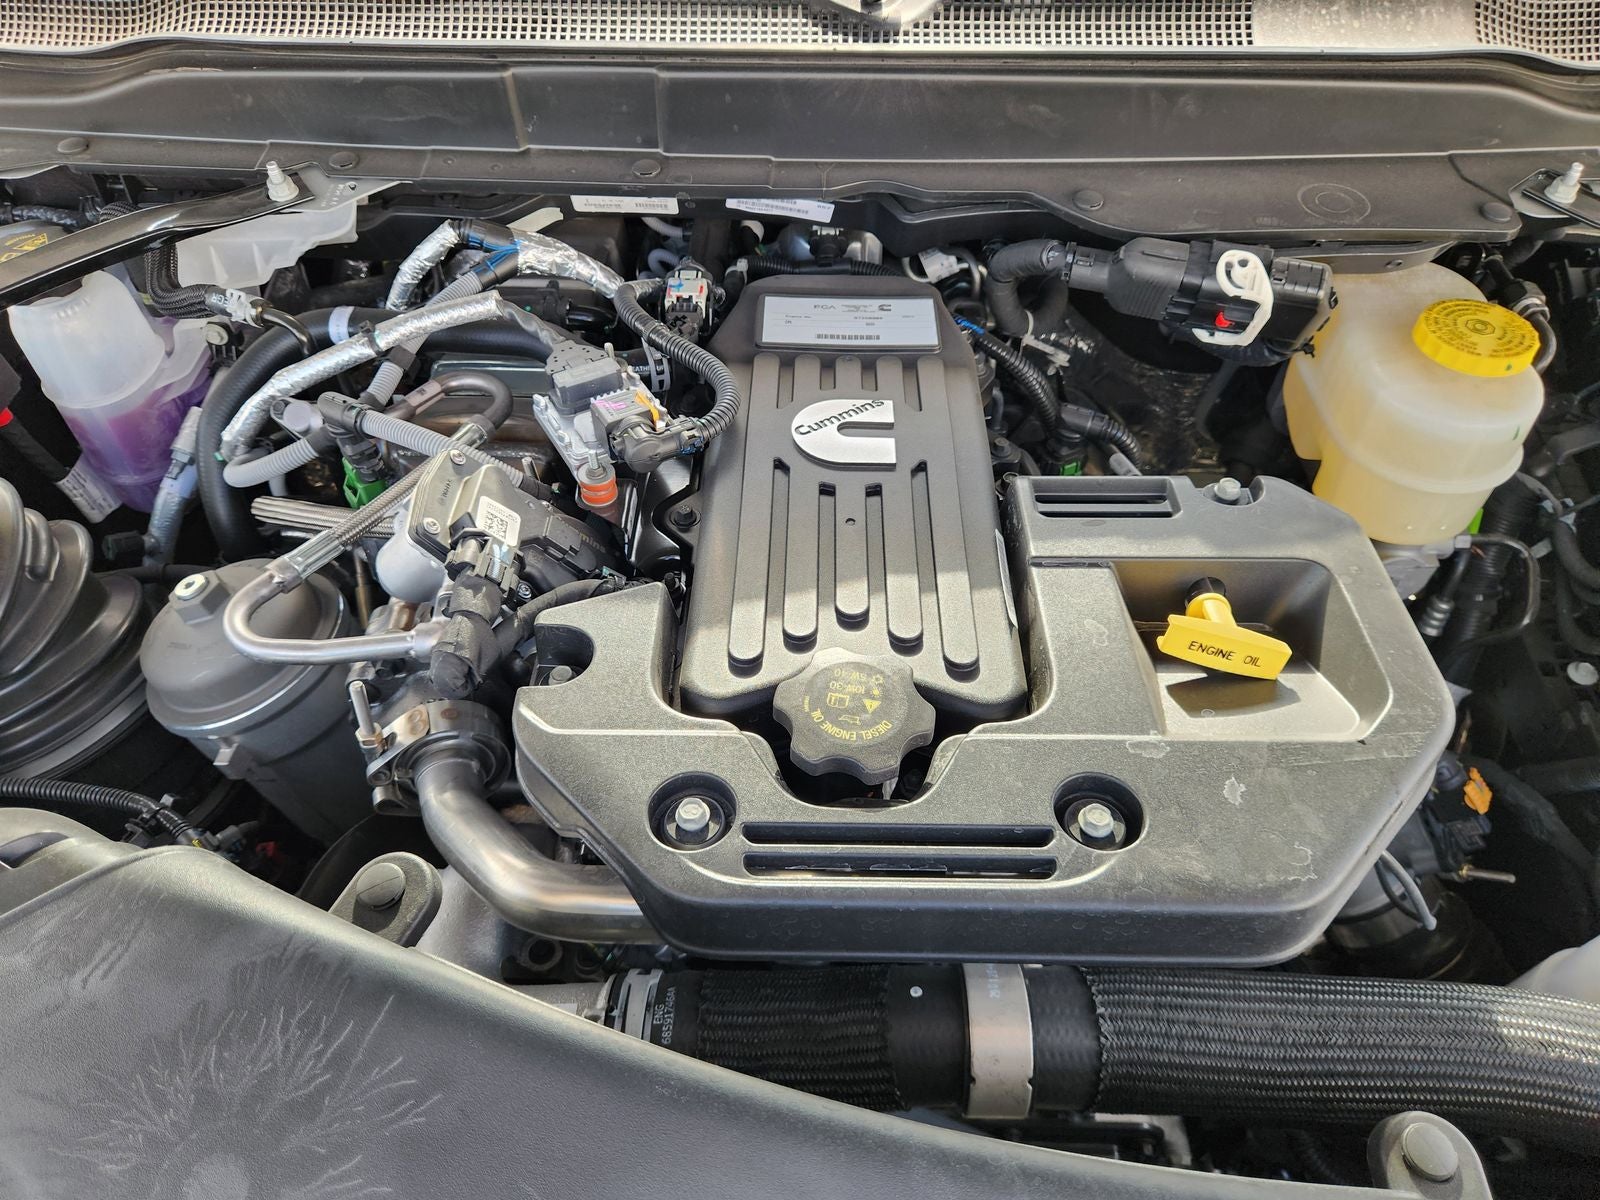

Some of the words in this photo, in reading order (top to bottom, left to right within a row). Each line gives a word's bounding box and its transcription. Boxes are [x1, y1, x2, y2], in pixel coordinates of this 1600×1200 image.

[794, 400, 885, 435] Cummins
[1187, 640, 1237, 661] ENGINE
[1243, 655, 1262, 668] OIL
[811, 708, 824, 723] OIL
[820, 721, 857, 741] ENGINE
[860, 720, 893, 741] DIESEL
[653, 1003, 665, 1025] ENG
